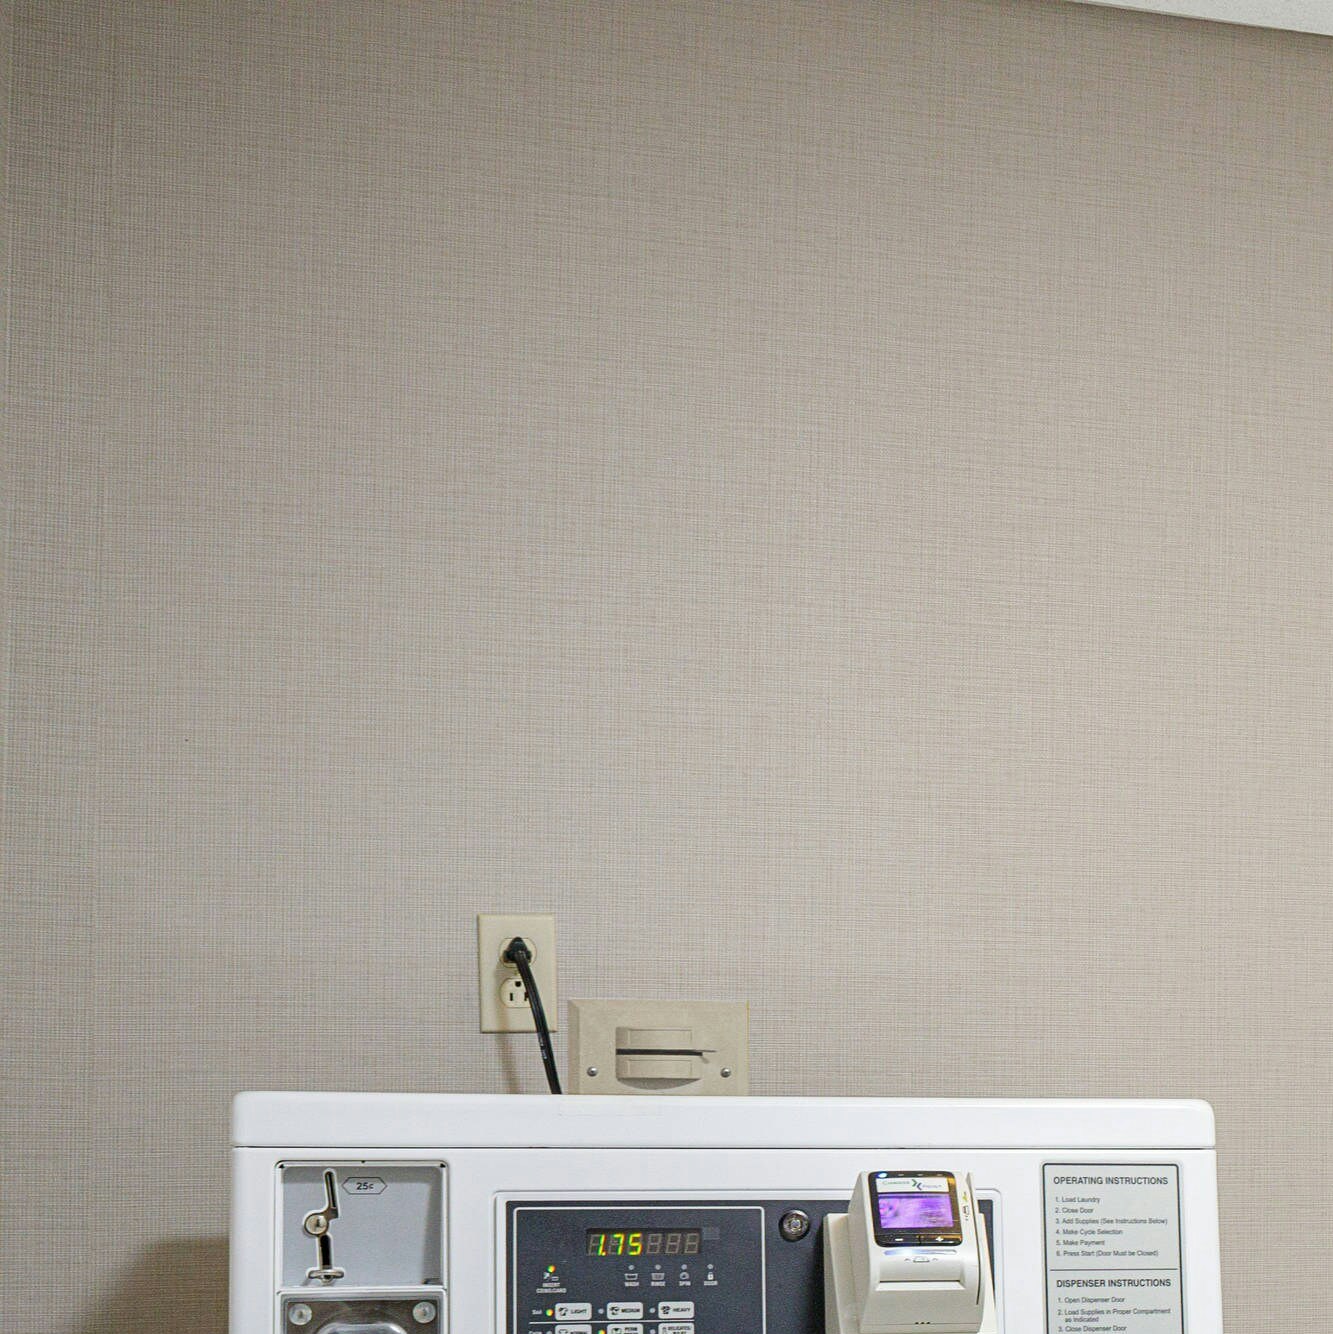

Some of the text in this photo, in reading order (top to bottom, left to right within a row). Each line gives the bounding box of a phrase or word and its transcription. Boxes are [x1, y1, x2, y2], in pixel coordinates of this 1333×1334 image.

[1054, 1177, 1168, 1185] OPERATING INSTRUCTIONS
[1057, 1279, 1171, 1288] DISPENSER INSTRUCTIONS
